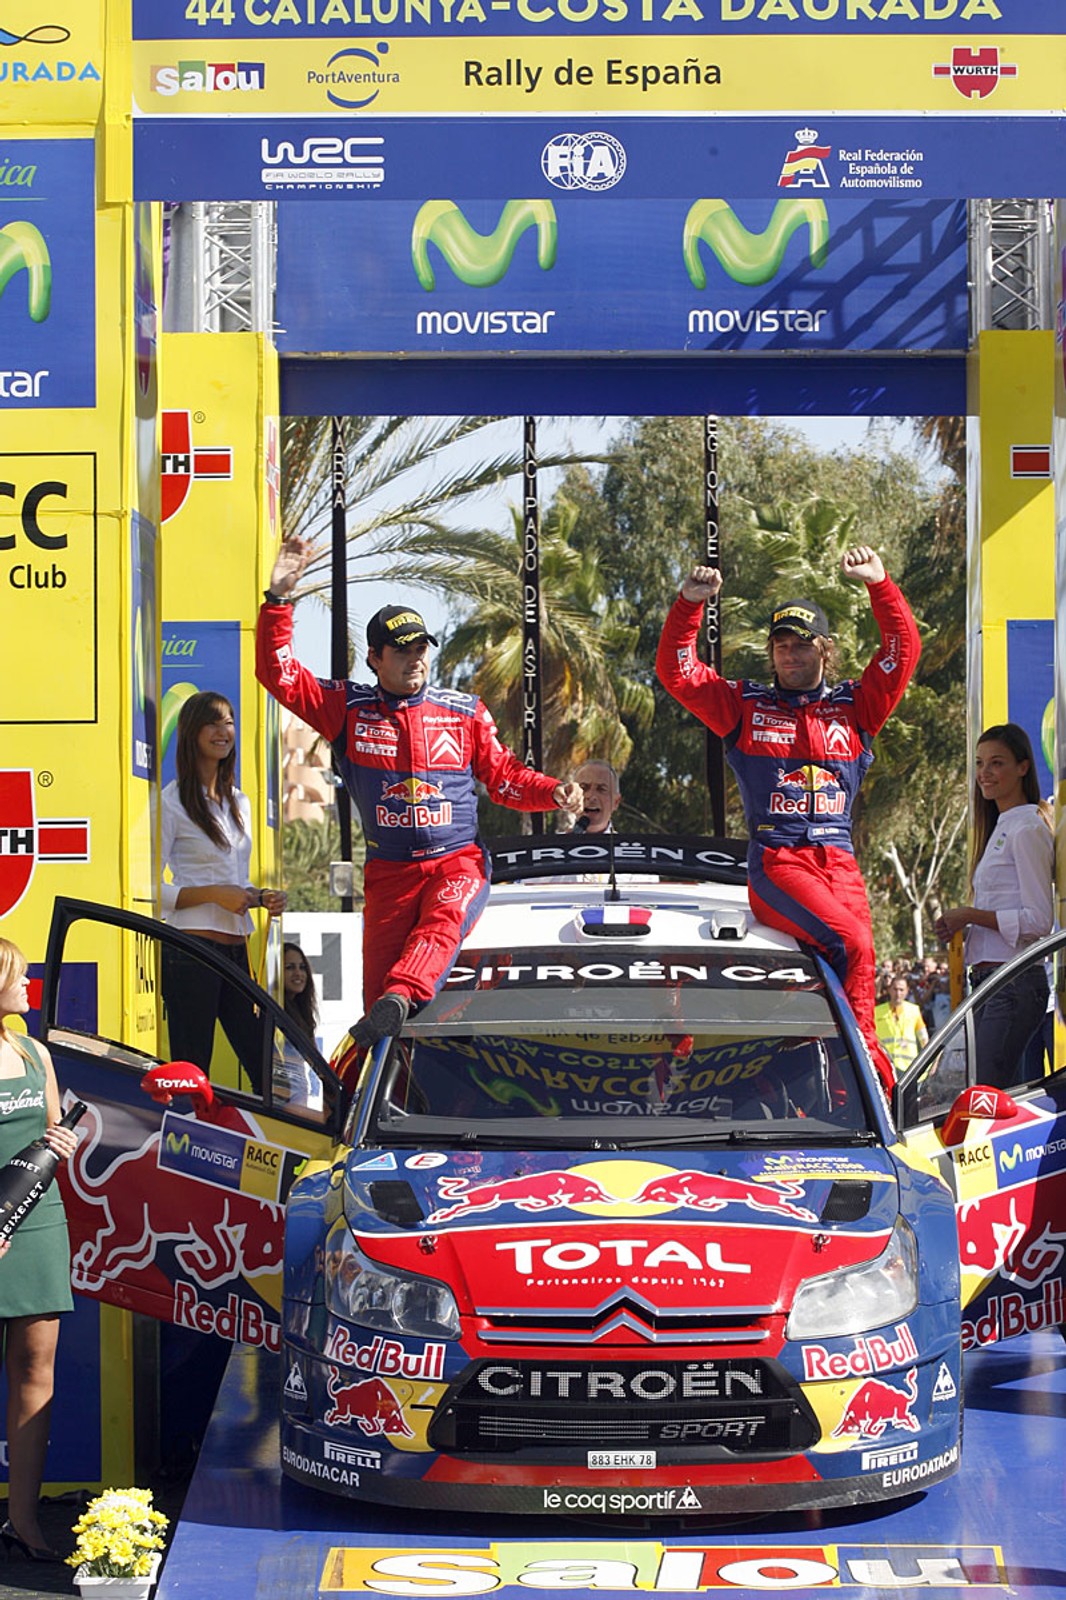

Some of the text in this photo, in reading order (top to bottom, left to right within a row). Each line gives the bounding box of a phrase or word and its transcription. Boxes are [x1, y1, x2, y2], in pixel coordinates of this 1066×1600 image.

[185, 0, 235, 25] 44
[307, 69, 399, 84] PortAventura
[464, 59, 722, 92] Rally de España
[261, 137, 385, 164] WRC
[839, 149, 923, 161] Real Federación
[849, 163, 914, 176] Española de
[840, 177, 923, 188] Automovilismo
[416, 310, 556, 334] movistar
[688, 308, 827, 333] movistar
[333, 416, 346, 509] VARRA
[707, 415, 719, 506] EGION
[525, 416, 538, 571] INCIPADO
[707, 521, 718, 558] DE
[9, 564, 67, 588] Club
[525, 586, 537, 622] DE
[369, 727, 398, 739] TOTAL
[766, 717, 796, 727] TOTAL
[376, 802, 452, 828] Red Bull
[770, 791, 846, 814] Red Bull
[696, 851, 748, 868] C
[446, 961, 812, 982] CITROËN C4
[155, 1078, 198, 1088] TOTAL
[191, 1145, 279, 1169] movistar RACC
[958, 1145, 991, 1168] RACC
[496, 1239, 751, 1274] TOTAL
[527, 1277, 622, 1287] Partenaires
[632, 1276, 684, 1286] depuis
[174, 1280, 237, 1340] Red
[325, 1325, 447, 1380] Red Bull
[802, 1323, 919, 1381] Red Bull
[477, 1362, 763, 1399] CITROËN
[659, 1416, 765, 1439] SPORT
[324, 1441, 381, 1469] PIRELLI
[591, 1455, 652, 1465] 883 EHK 78
[861, 1441, 919, 1470] PIRELLI
[883, 1447, 959, 1487] EURODATACAR
[282, 1449, 360, 1487] EURODATACAR
[544, 1490, 676, 1513] le coq sportif
